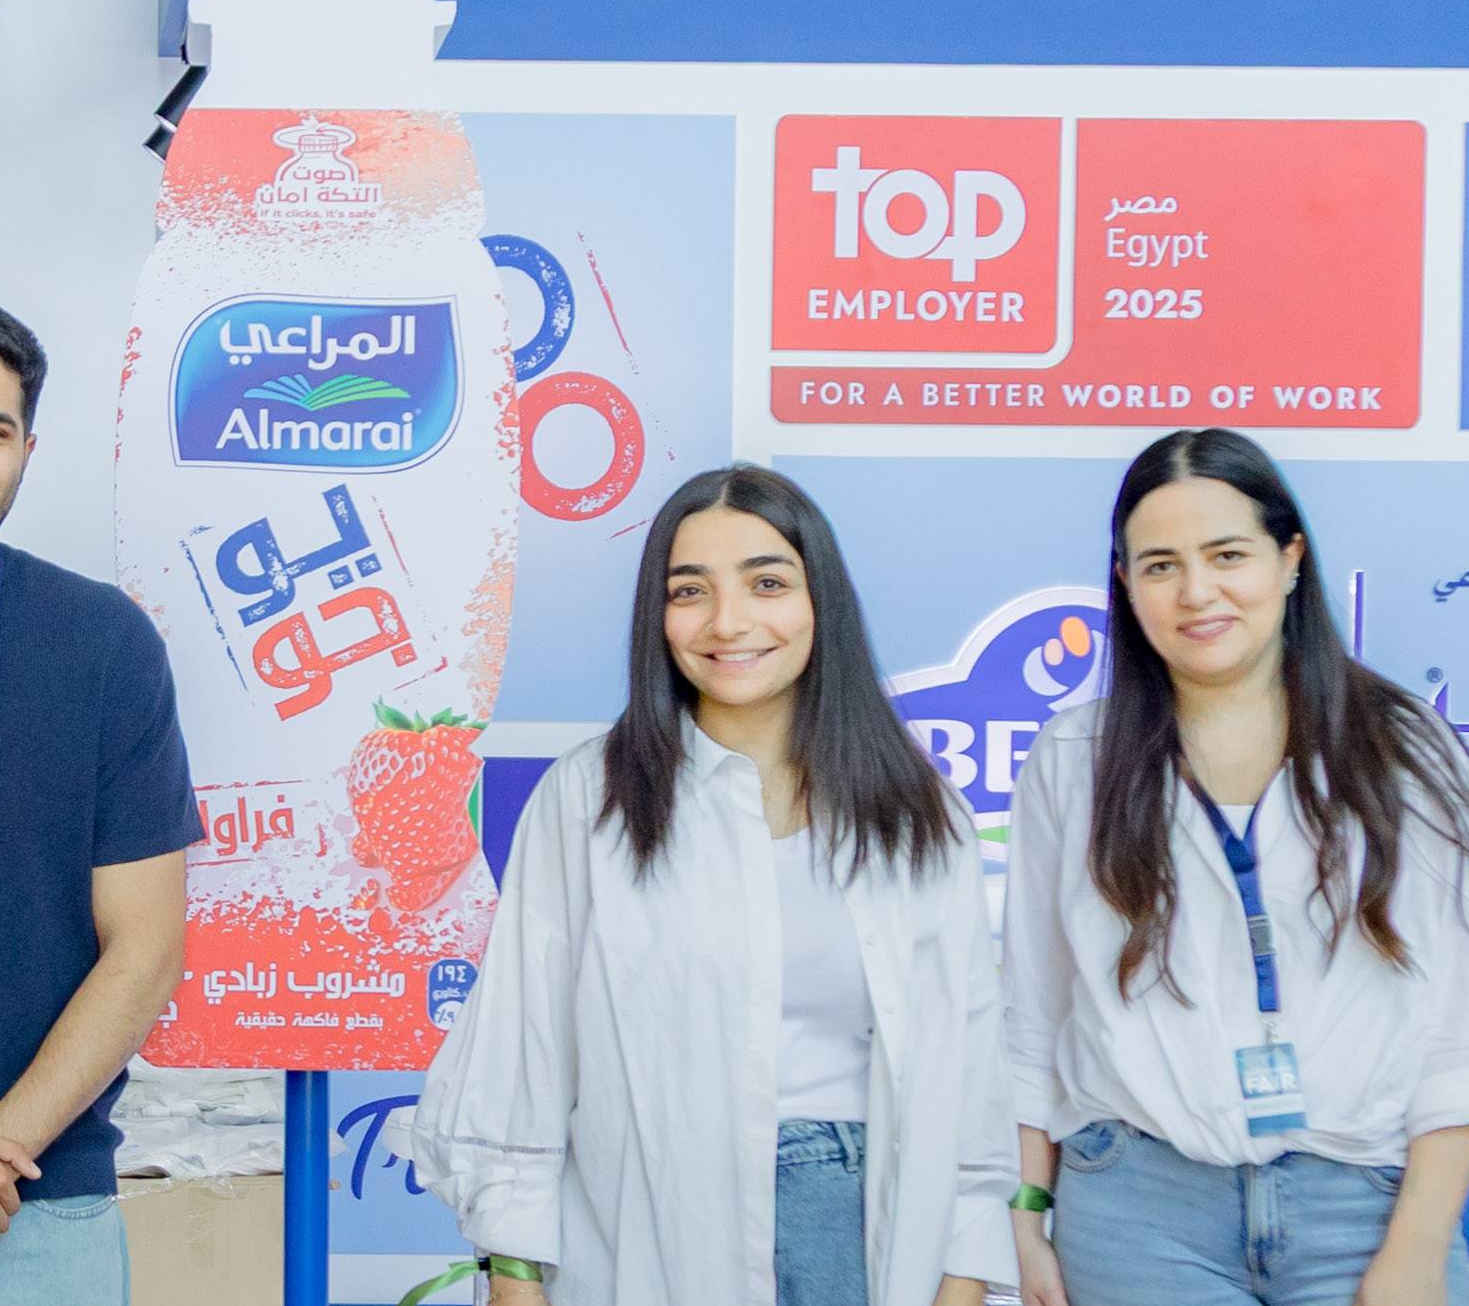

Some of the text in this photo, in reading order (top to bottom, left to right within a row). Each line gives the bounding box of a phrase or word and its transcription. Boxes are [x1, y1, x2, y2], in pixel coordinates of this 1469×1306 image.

[293, 165, 346, 184] صوت
[317, 186, 378, 203] التكة
[1104, 194, 1178, 221] مصر
[349, 209, 377, 218] safe
[811, 145, 1028, 282] top
[1107, 227, 1210, 267] Egypt
[807, 288, 1024, 324] EMPLOYER
[1104, 288, 1204, 320] 2025
[219, 314, 417, 372] المراعي
[801, 381, 1382, 411] FOR A BETTER WORLD OF WORK
[215, 407, 416, 451] Almarai
[203, 958, 407, 1006] مشروب زبادي
[235, 1010, 385, 1031] بقطع فاكهة حقيقية
